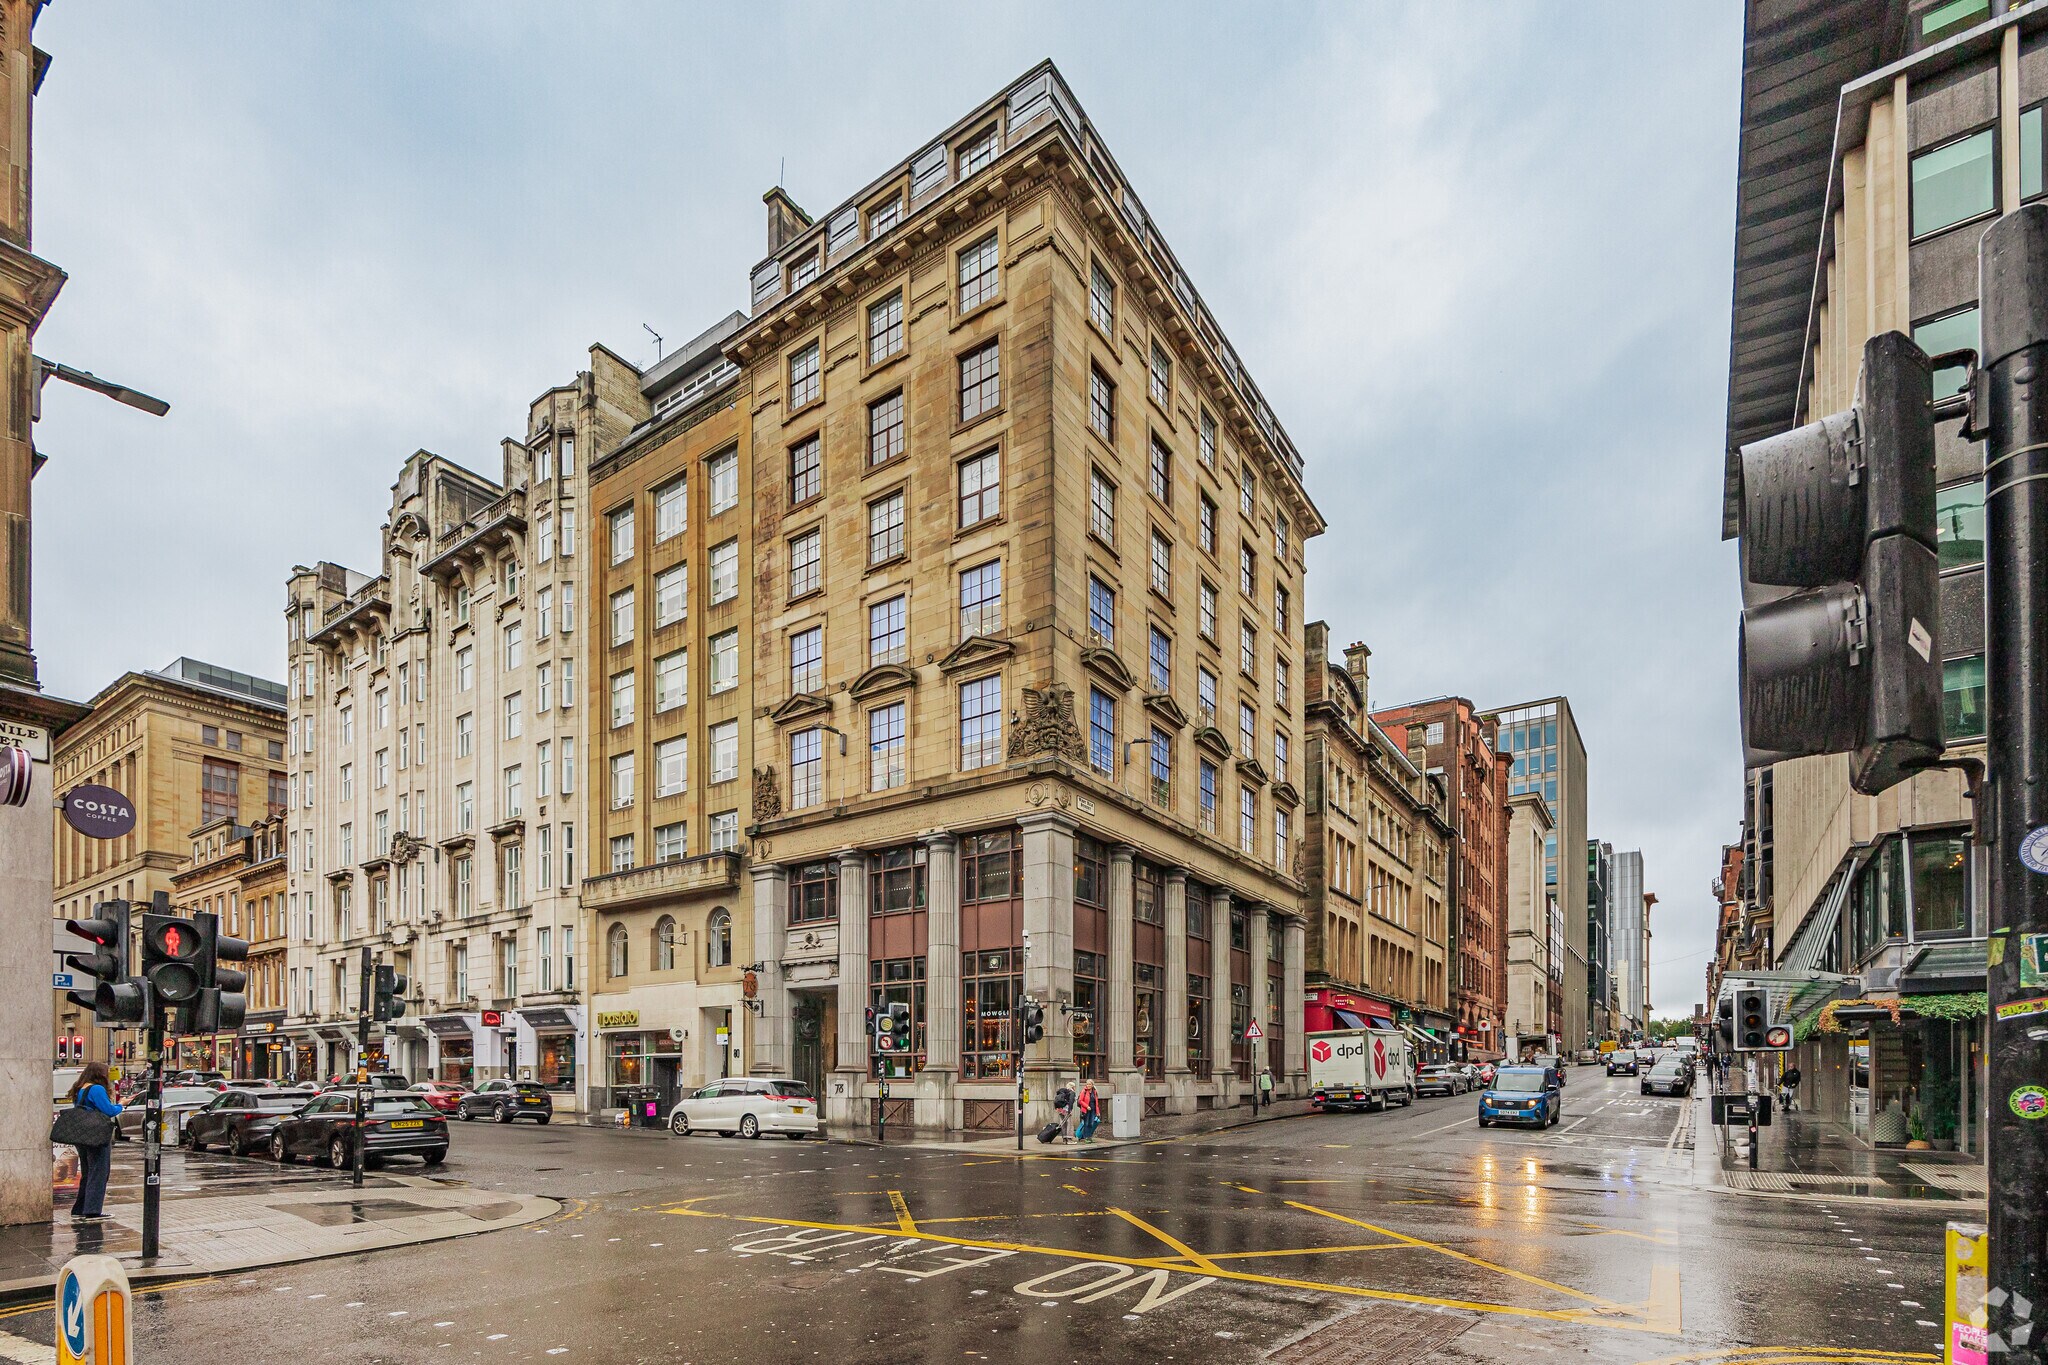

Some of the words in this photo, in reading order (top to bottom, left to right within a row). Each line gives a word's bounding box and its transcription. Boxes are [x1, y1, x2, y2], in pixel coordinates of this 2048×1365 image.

[73, 798, 130, 818] COSTA
[86, 812, 117, 822] COFFEE
[1336, 1042, 1363, 1059] dpd
[1388, 1047, 1400, 1070] dpd
[1952, 1322, 1988, 1337] PEOPLE
